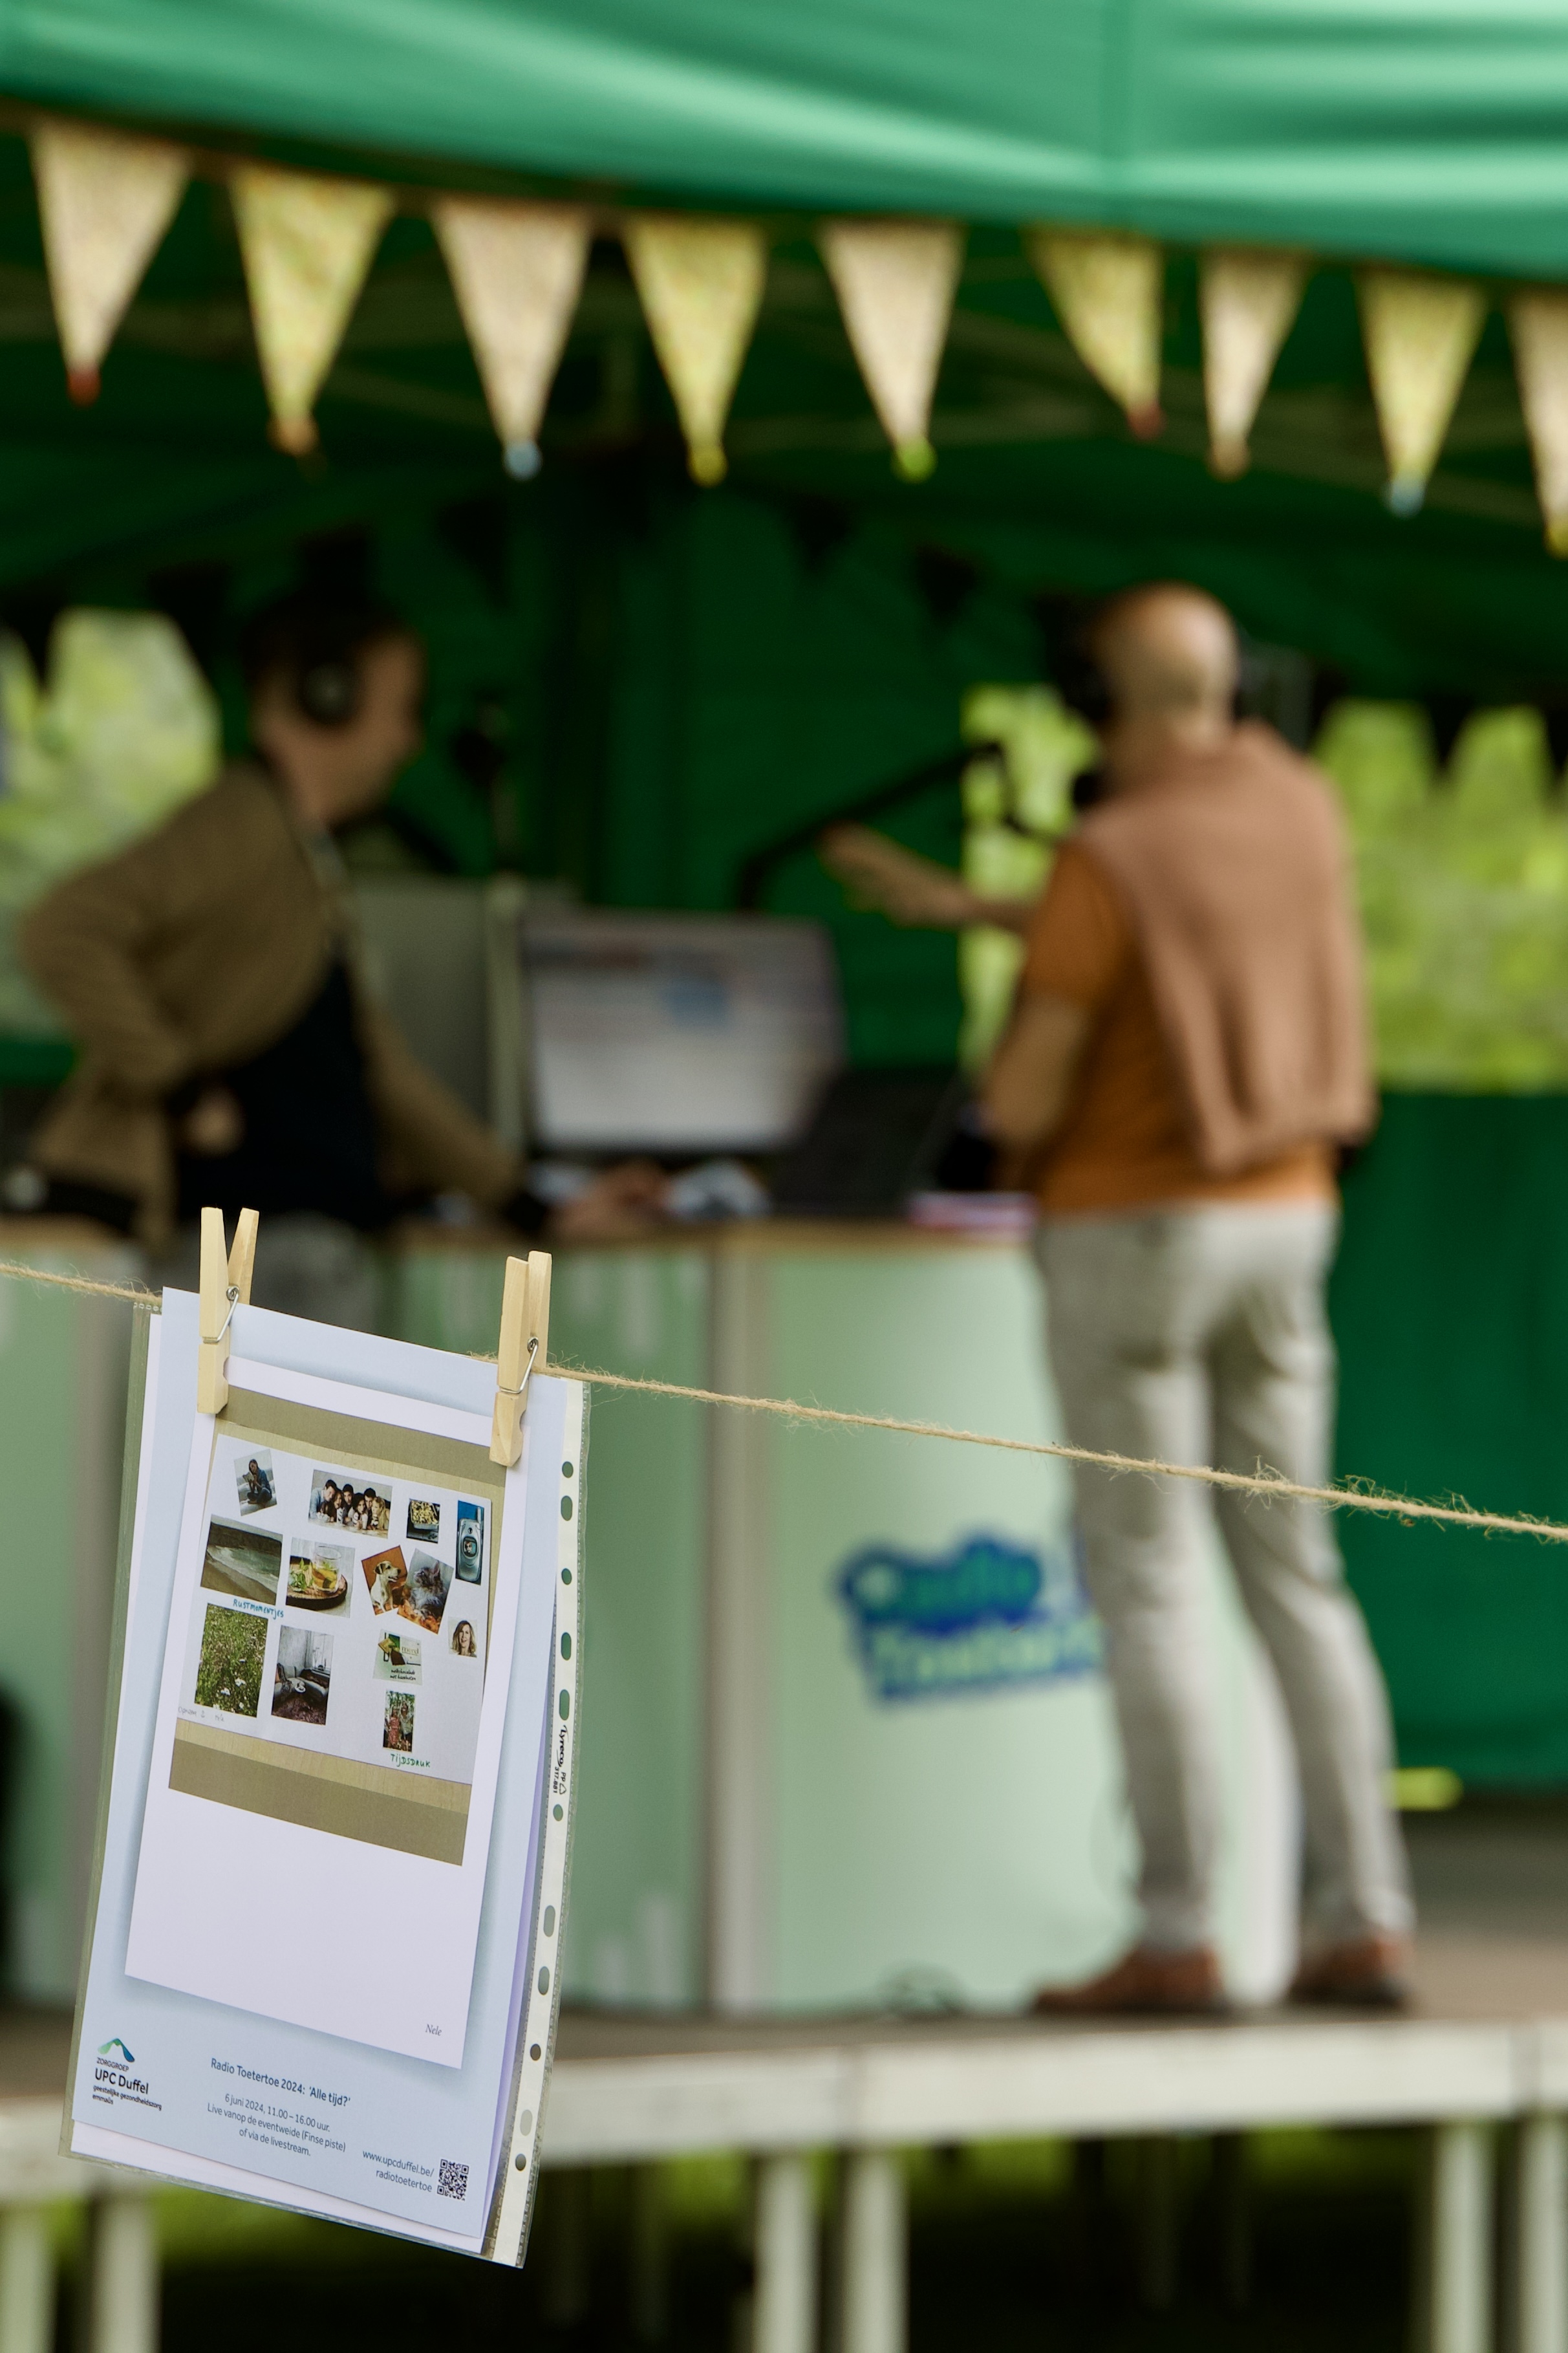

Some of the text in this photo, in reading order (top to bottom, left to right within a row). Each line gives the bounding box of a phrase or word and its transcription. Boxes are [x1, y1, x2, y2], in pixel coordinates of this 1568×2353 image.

[557, 1725, 568, 1767] Lyreco
[560, 1772, 566, 1782] PP
[425, 2024, 442, 2036] Nele
[96, 2057, 129, 2072] ZORGGROEP
[211, 2057, 235, 2074] Radio
[237, 2065, 279, 2087] Toetertoe
[281, 2078, 305, 2095] 2024:
[95, 2068, 149, 2095] UPC Duffel
[93, 2085, 162, 2111] geestelijke gezondheidszorg
[225, 2094, 230, 2102] 6
[230, 2094, 244, 2105] juni
[245, 2099, 266, 2114] 2024,
[268, 2106, 288, 2120] 11.00
[295, 2114, 316, 2128] 16.00
[317, 2123, 330, 2132] uur.
[208, 2103, 346, 2152] Live vanop de eventweide (Finse piste)
[239, 2127, 311, 2156] of via de livestream.
[362, 2151, 435, 2178] www.upcduffel.be/
[376, 2169, 433, 2193] radiotoetertoe
